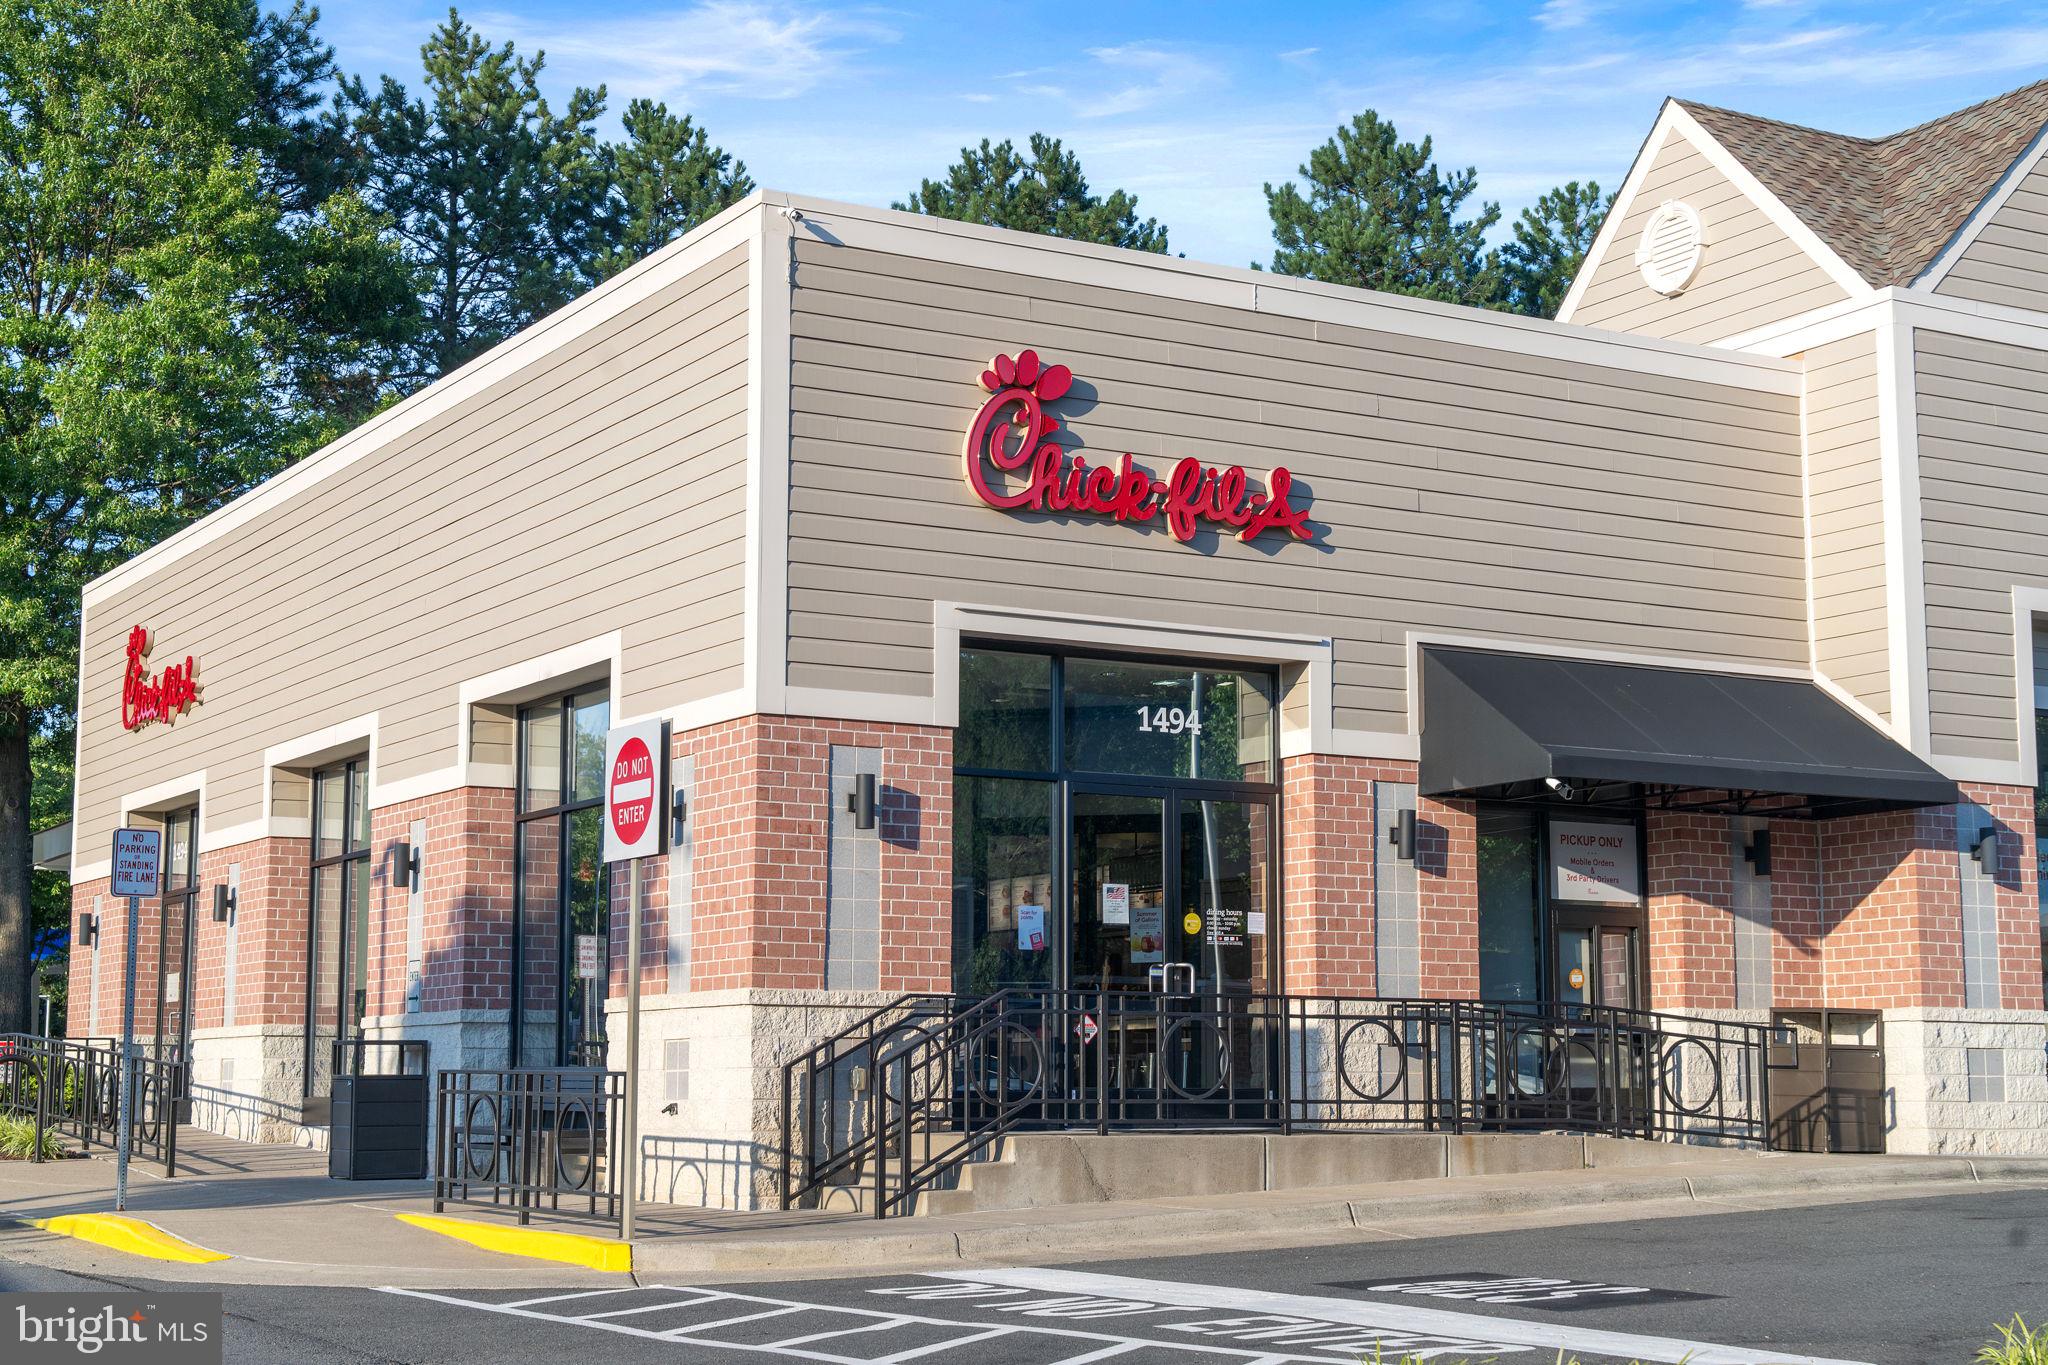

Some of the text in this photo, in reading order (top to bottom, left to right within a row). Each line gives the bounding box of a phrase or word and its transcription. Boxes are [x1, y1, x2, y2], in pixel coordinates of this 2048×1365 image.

[1137, 705, 1203, 736] 1494
[617, 756, 649, 779] DO NOT
[618, 804, 645, 826] ENTER
[132, 833, 145, 843] NO
[1560, 834, 1623, 848] PICKUP ONLY
[119, 843, 156, 855] PARKING
[119, 860, 154, 871] STANDING
[1570, 857, 1615, 867] Mobile Orders
[118, 871, 155, 883] FIRE LANE
[1566, 873, 1619, 884] 3rd Party Drivers
[1206, 908, 1243, 917] dining hours
[865, 1282, 1537, 1360] DO NOT ENTER
